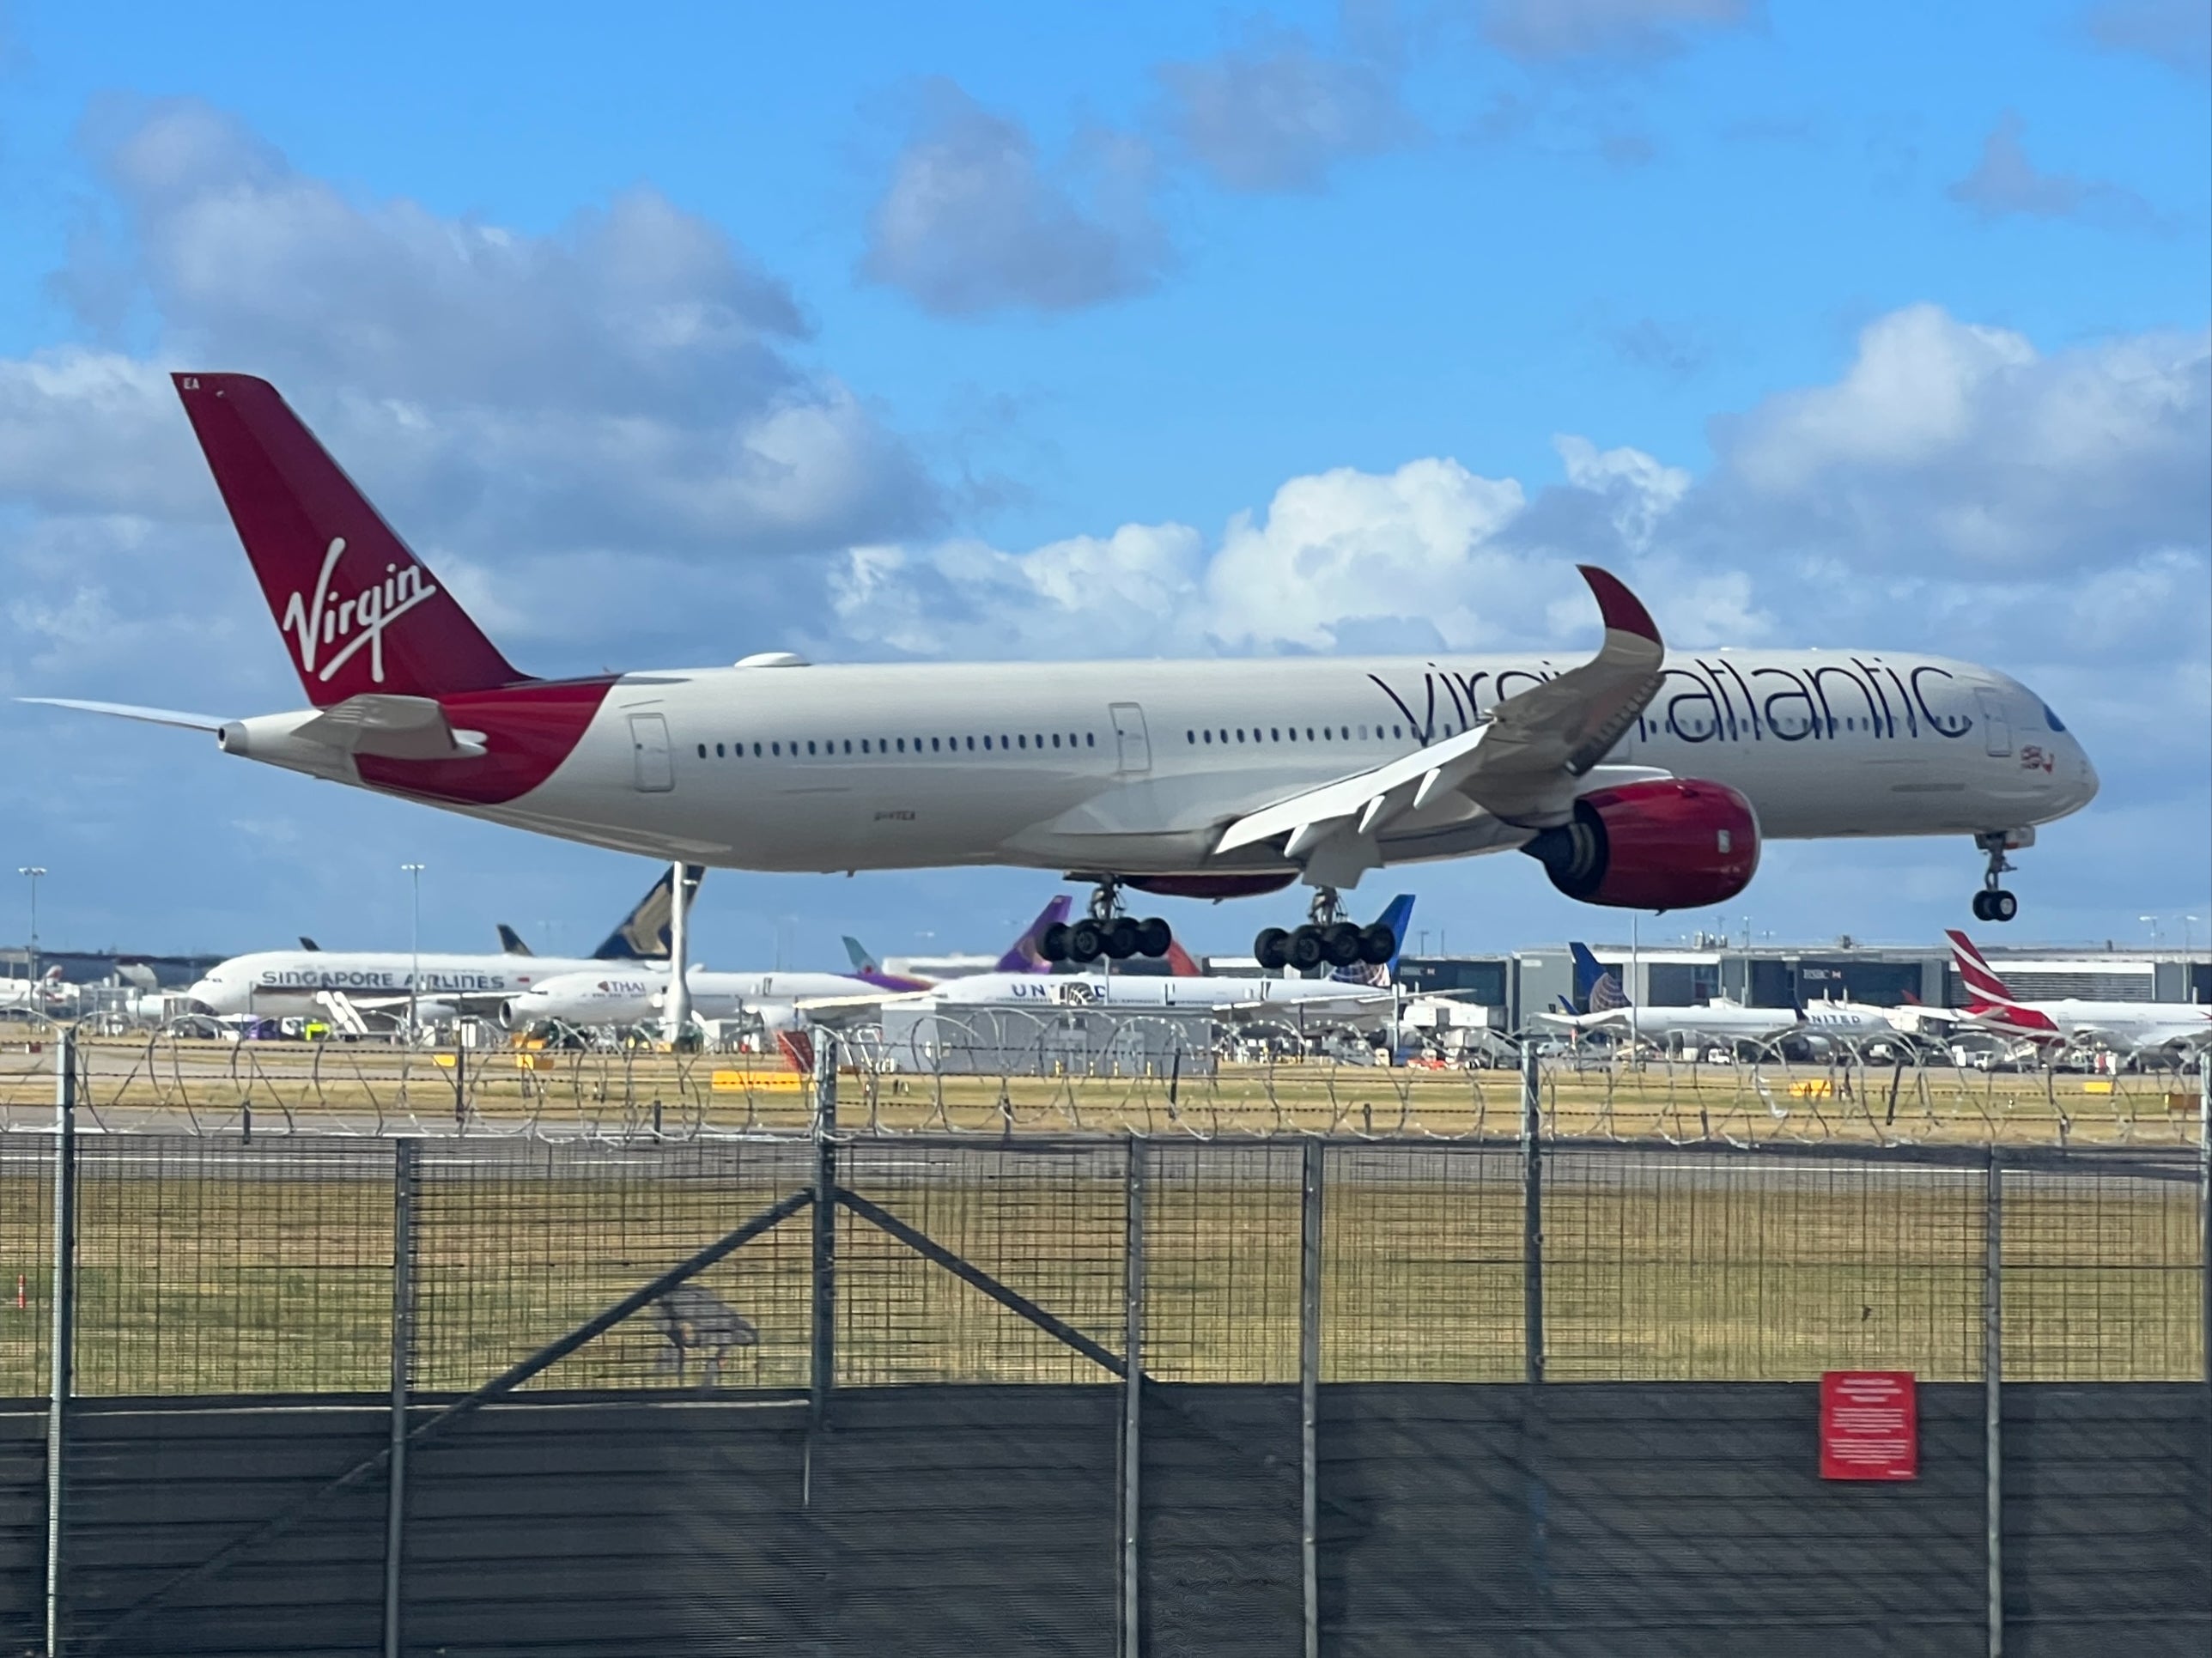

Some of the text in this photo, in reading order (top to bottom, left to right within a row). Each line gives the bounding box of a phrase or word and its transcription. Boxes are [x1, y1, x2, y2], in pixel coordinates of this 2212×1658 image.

[183, 377, 200, 390] EA
[283, 537, 436, 683] Virgin
[1659, 657, 1973, 743] atlantic
[261, 970, 394, 987] SINGAPORE
[611, 981, 647, 993] THAI
[1011, 983, 1107, 999] UND
[1808, 1014, 1862, 1024] NITED
